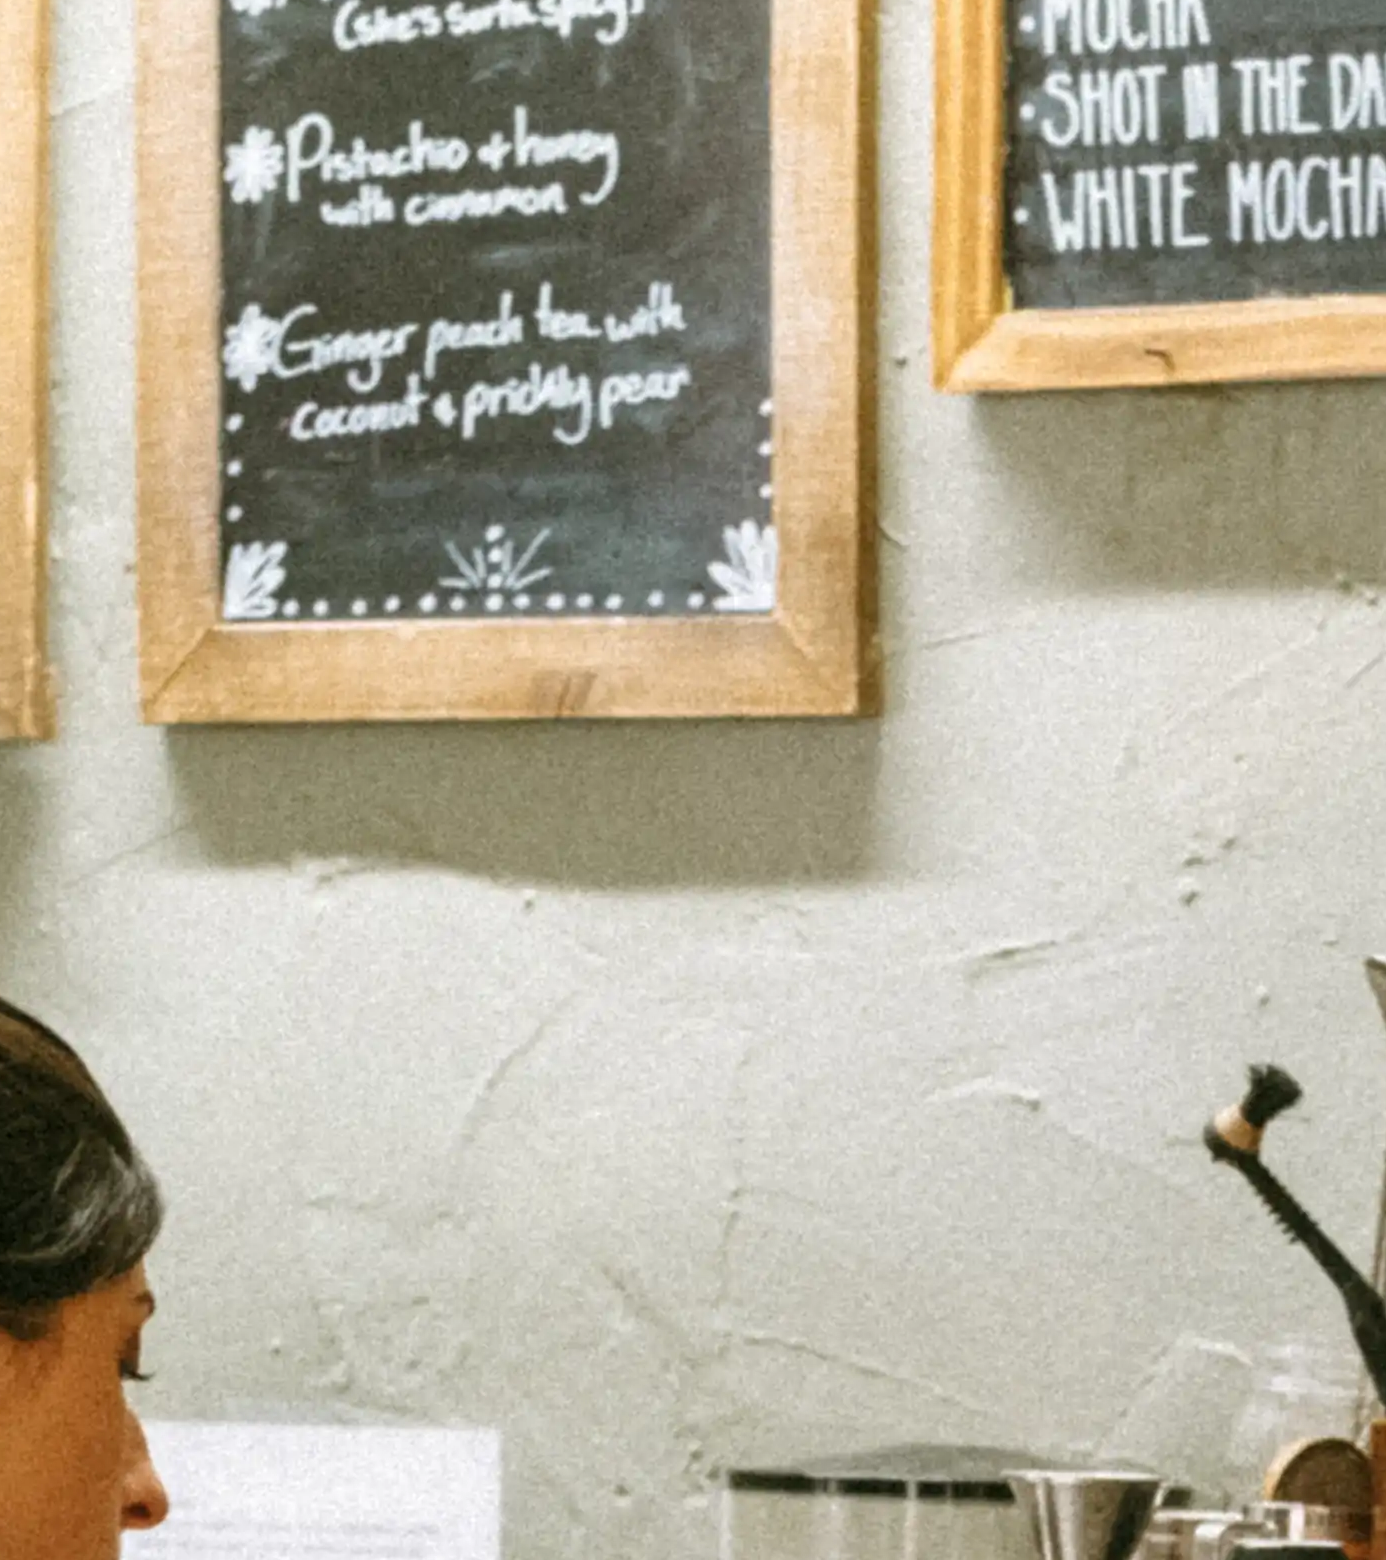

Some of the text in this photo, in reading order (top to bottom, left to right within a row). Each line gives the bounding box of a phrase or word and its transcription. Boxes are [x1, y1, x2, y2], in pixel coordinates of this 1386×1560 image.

[1041, 65, 1166, 147] SHOT
[1182, 63, 1219, 140] IN
[1232, 55, 1322, 135] THE
[286, 113, 469, 203] Pistachio
[513, 105, 621, 205] honey
[321, 182, 568, 227] with cinnamon
[1041, 164, 1212, 253] WHITE
[274, 281, 688, 393] Ginger peach tea with
[600, 363, 691, 429] pear
